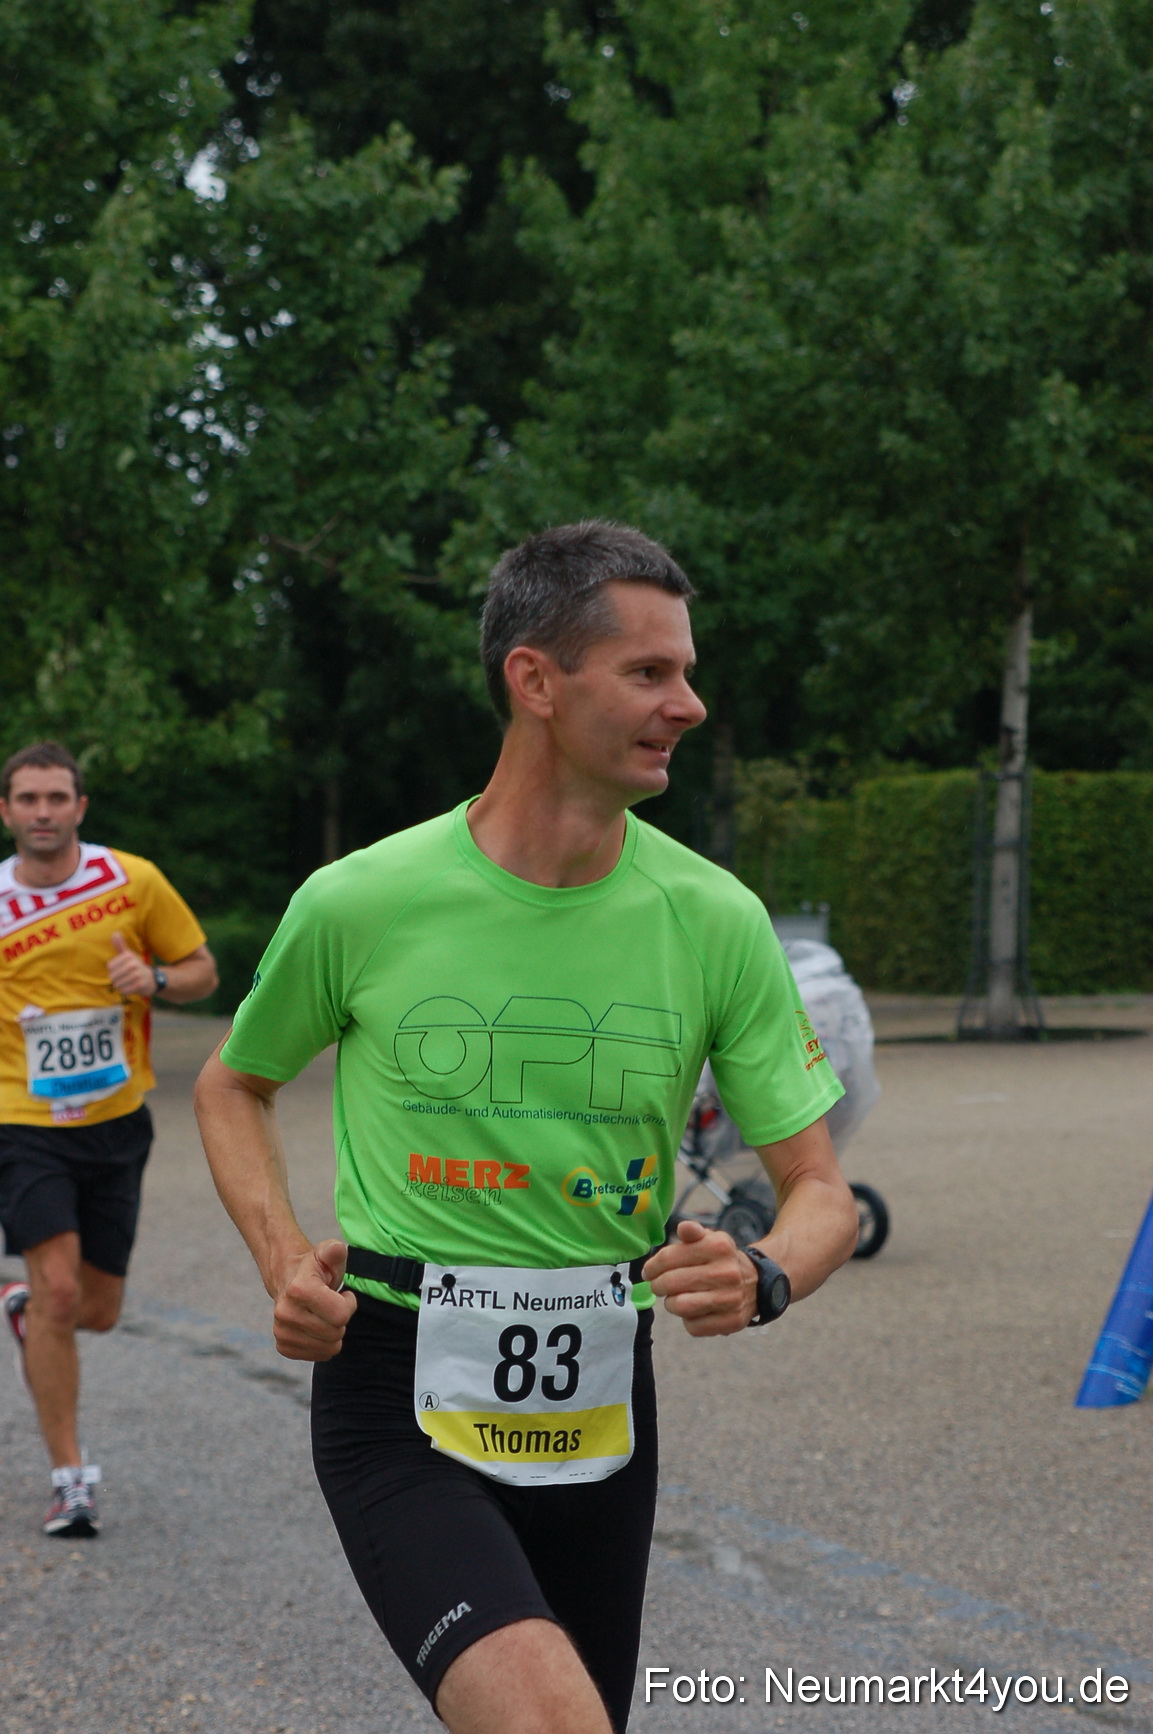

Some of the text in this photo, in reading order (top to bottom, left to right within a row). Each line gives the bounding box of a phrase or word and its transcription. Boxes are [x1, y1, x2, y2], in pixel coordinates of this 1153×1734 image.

[4, 895, 136, 963] MAX BÖGL
[38, 1029, 113, 1072] 2896
[402, 1100, 667, 1127] Gebäude- und Automatisierungstechnik Gmb
[402, 1171, 502, 1205] Reisen
[409, 1153, 530, 1189] MERZ
[427, 1286, 608, 1312] PARTL Neumarkt
[493, 1323, 582, 1403] 83
[473, 1423, 582, 1454] Thomas
[416, 1601, 472, 1667] TRIGEMA
